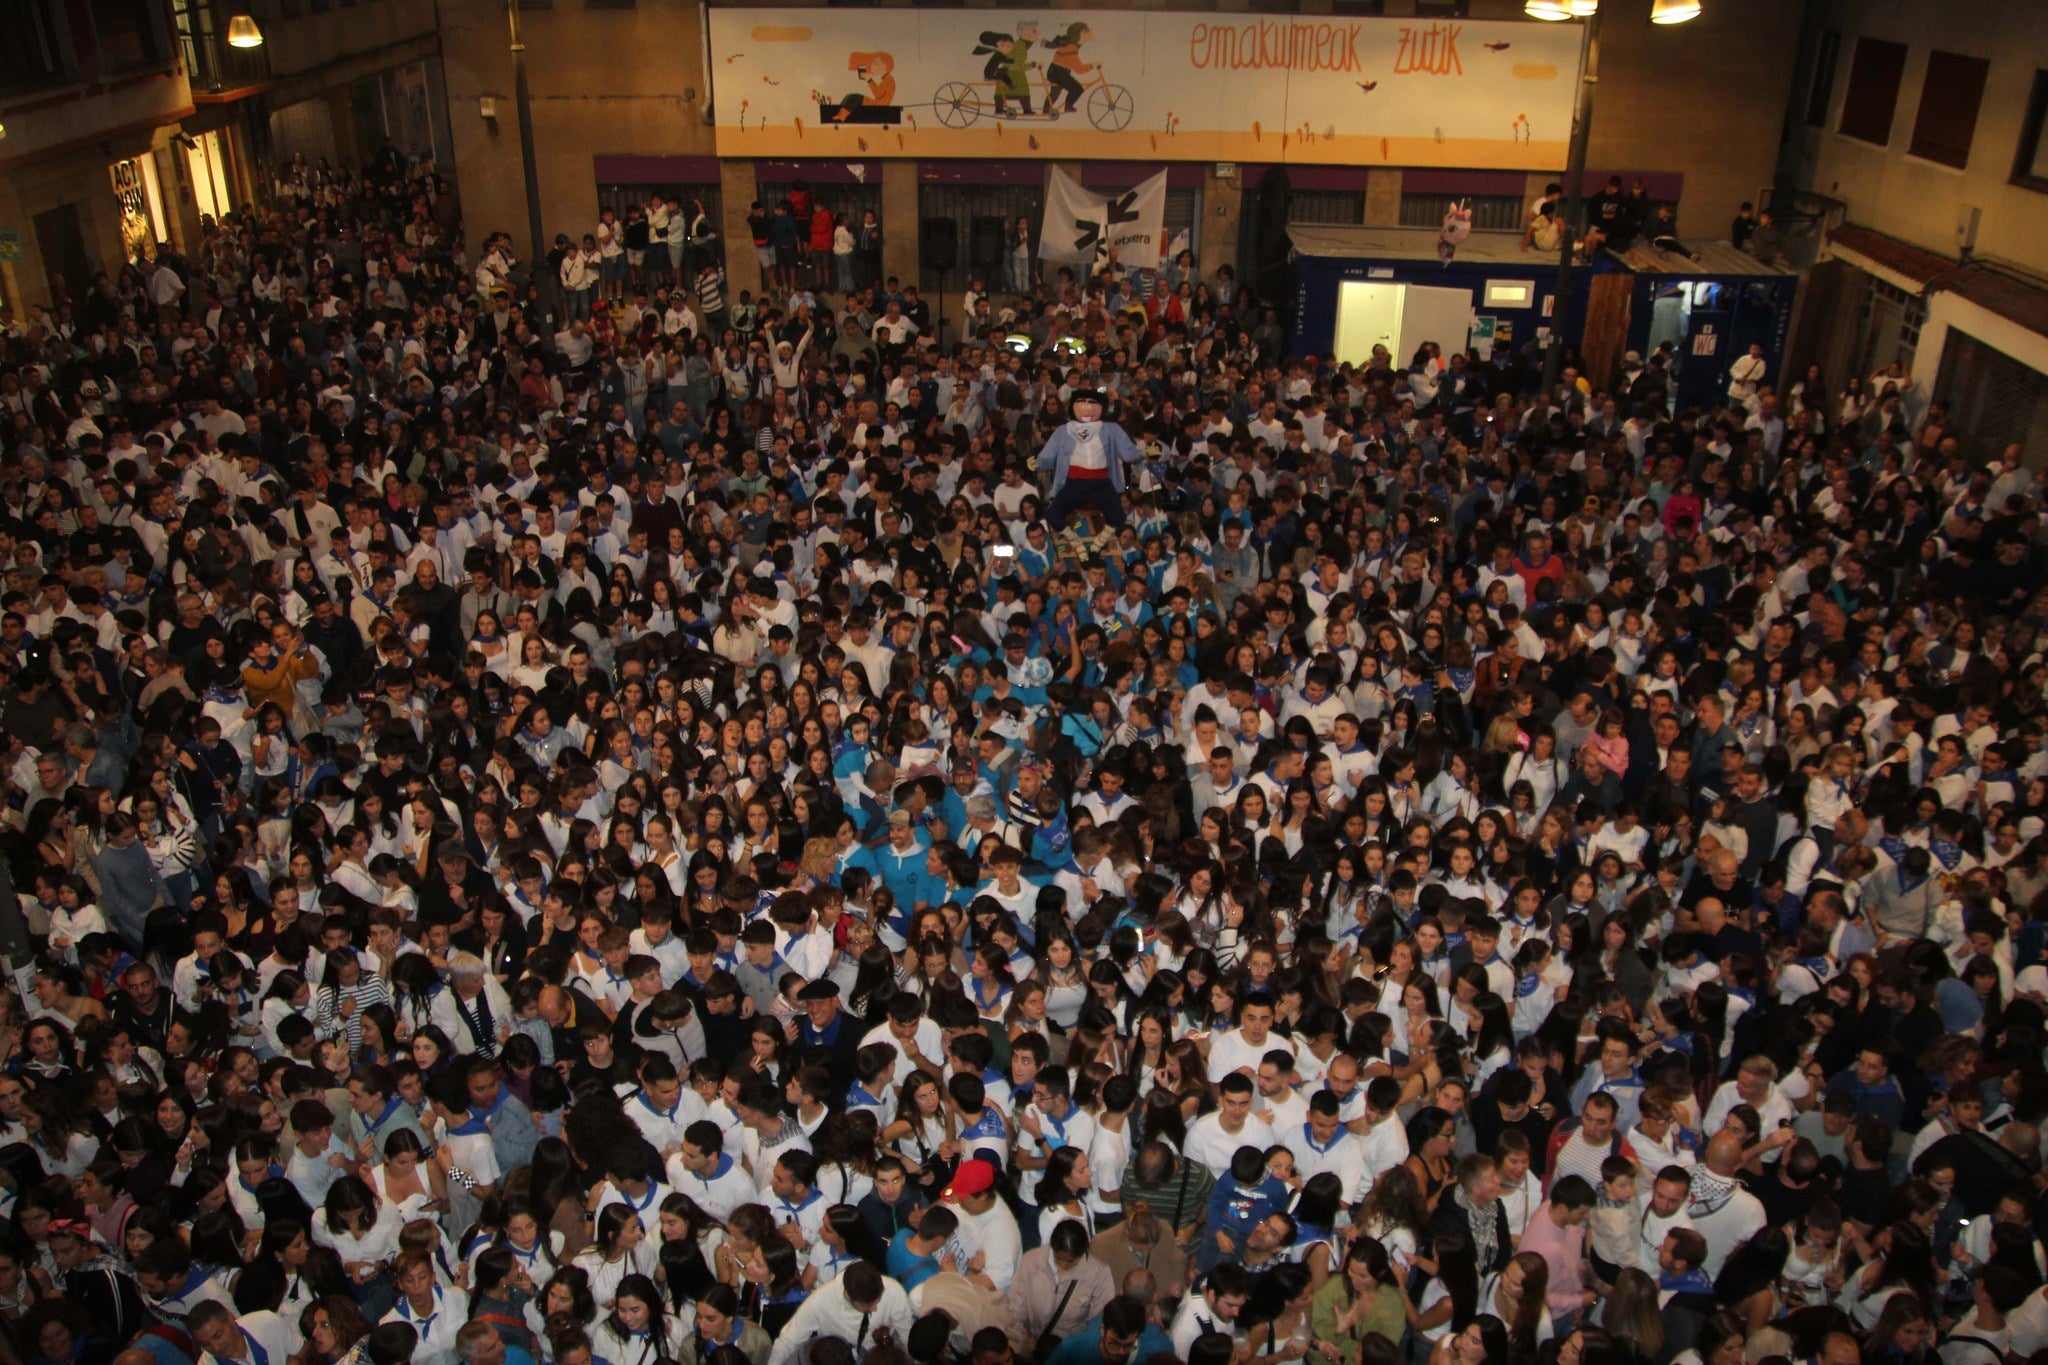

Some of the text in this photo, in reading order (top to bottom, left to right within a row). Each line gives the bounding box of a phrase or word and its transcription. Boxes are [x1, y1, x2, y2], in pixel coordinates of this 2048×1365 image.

[1191, 17, 1463, 76] emakumeak zutik
[114, 160, 137, 189] ACT
[115, 184, 145, 216] NOW
[1114, 232, 1151, 247] etxera
[1696, 335, 1716, 354] WC
